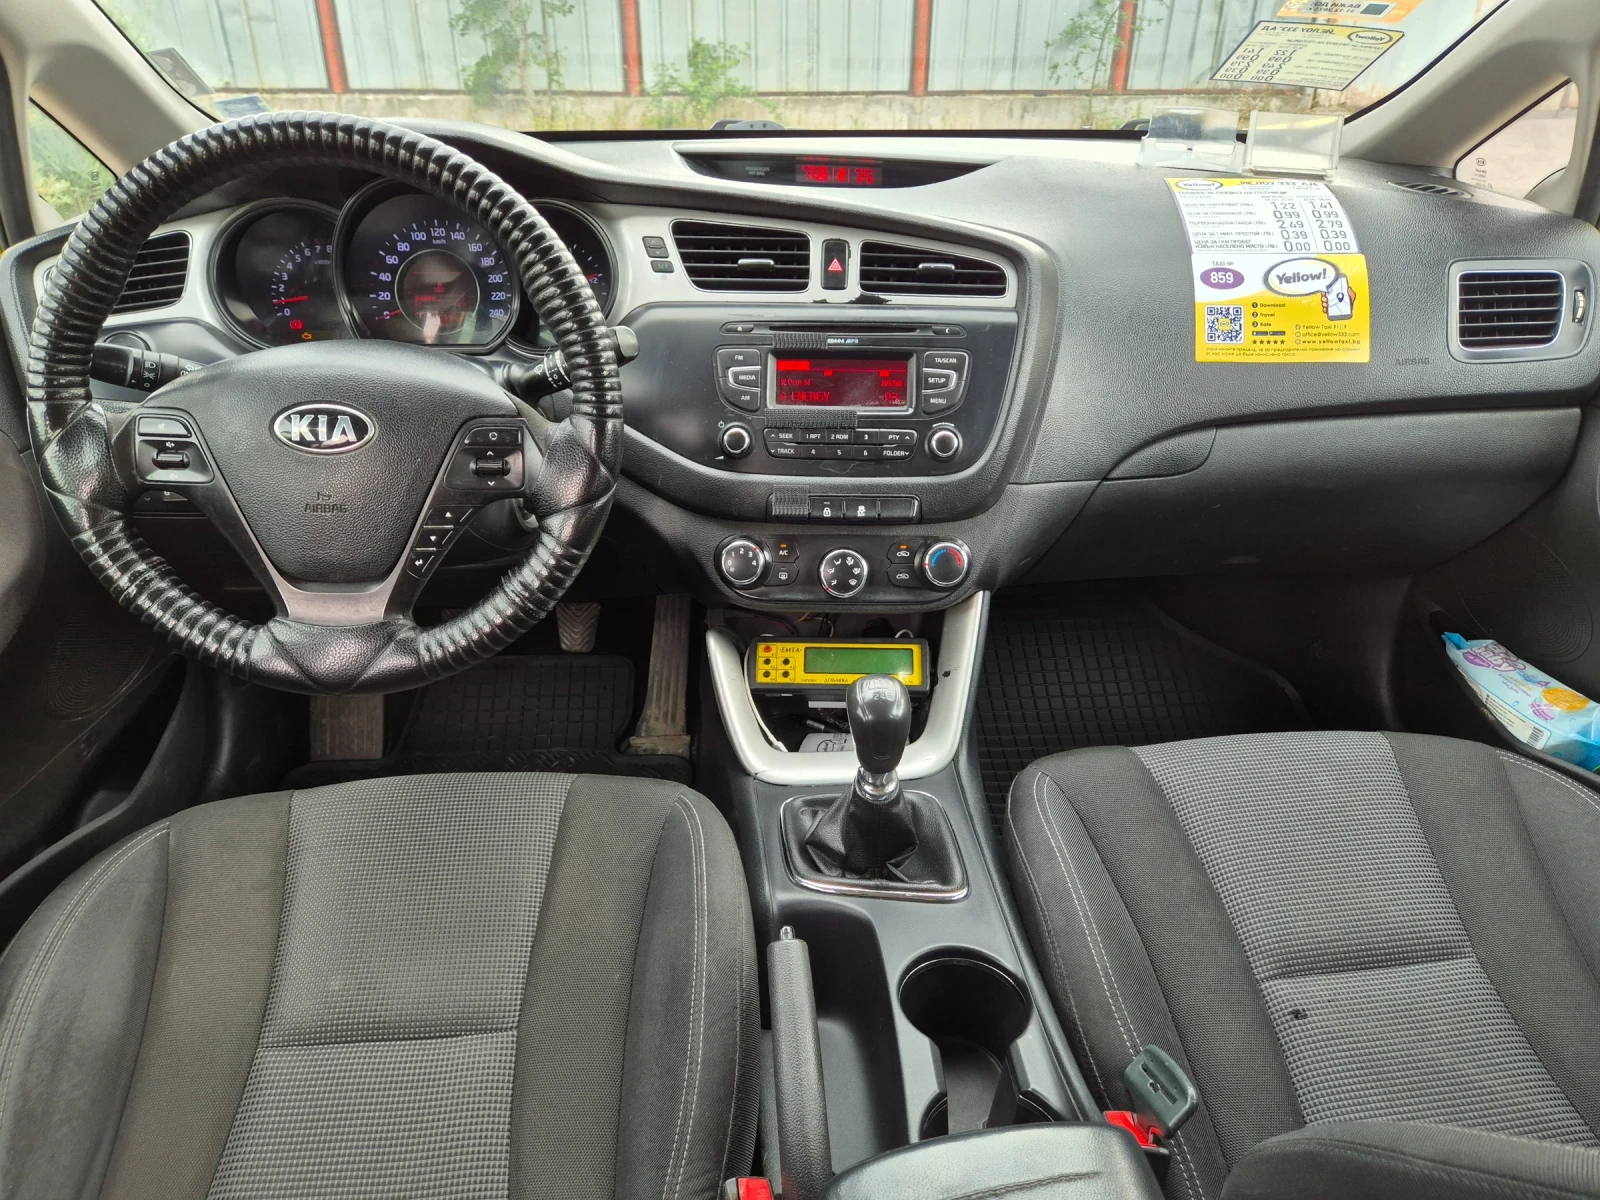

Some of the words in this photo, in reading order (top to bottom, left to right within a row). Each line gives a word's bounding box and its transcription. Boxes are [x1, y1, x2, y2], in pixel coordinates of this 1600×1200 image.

[1308, 202, 1332, 210] 1.41
[1273, 210, 1300, 219] 0.99
[1312, 210, 1339, 218] 0.99
[1276, 220, 1304, 229] 2.49
[1316, 219, 1343, 228] 2.79
[410, 232, 426, 241] 100
[430, 228, 445, 236] 120
[450, 232, 465, 240] 140
[1280, 230, 1308, 240] 0.39
[1320, 229, 1347, 239] 0.39
[397, 242, 410, 252] 80
[468, 243, 482, 252] 160
[1284, 240, 1311, 252] 0.00
[1324, 240, 1350, 251] 0.00
[386, 256, 399, 264] 60
[480, 257, 495, 266] 180
[379, 273, 391, 281] 40
[488, 275, 502, 283] 200
[1210, 272, 1234, 284] 859
[1276, 268, 1327, 284] Yellow!
[378, 292, 390, 300] 20
[491, 292, 506, 300] 220
[489, 309, 504, 317] 240
[792, 391, 830, 401] ENERGY
[291, 414, 357, 442] KIA
[304, 503, 348, 513] AIRBAG
